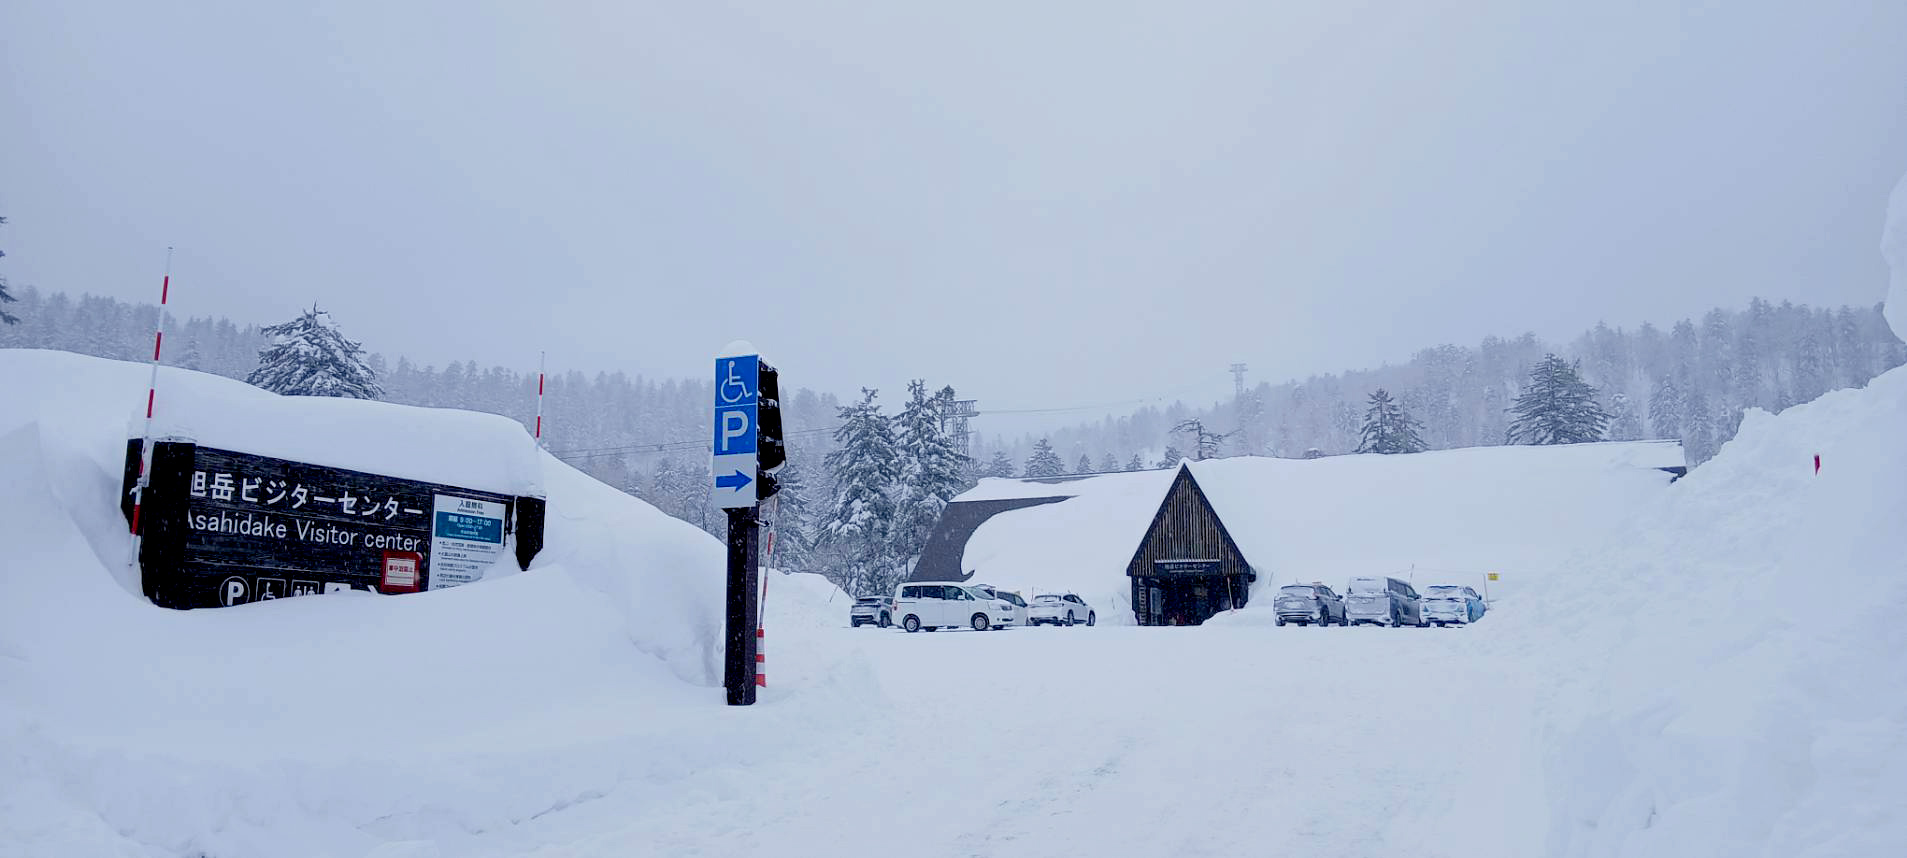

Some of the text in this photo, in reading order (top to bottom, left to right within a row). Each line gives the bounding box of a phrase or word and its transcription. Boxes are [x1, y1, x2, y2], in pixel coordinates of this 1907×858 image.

[722, 411, 749, 451] P
[296, 519, 359, 546] Visitor
[364, 533, 421, 552] center
[227, 581, 245, 606] P
